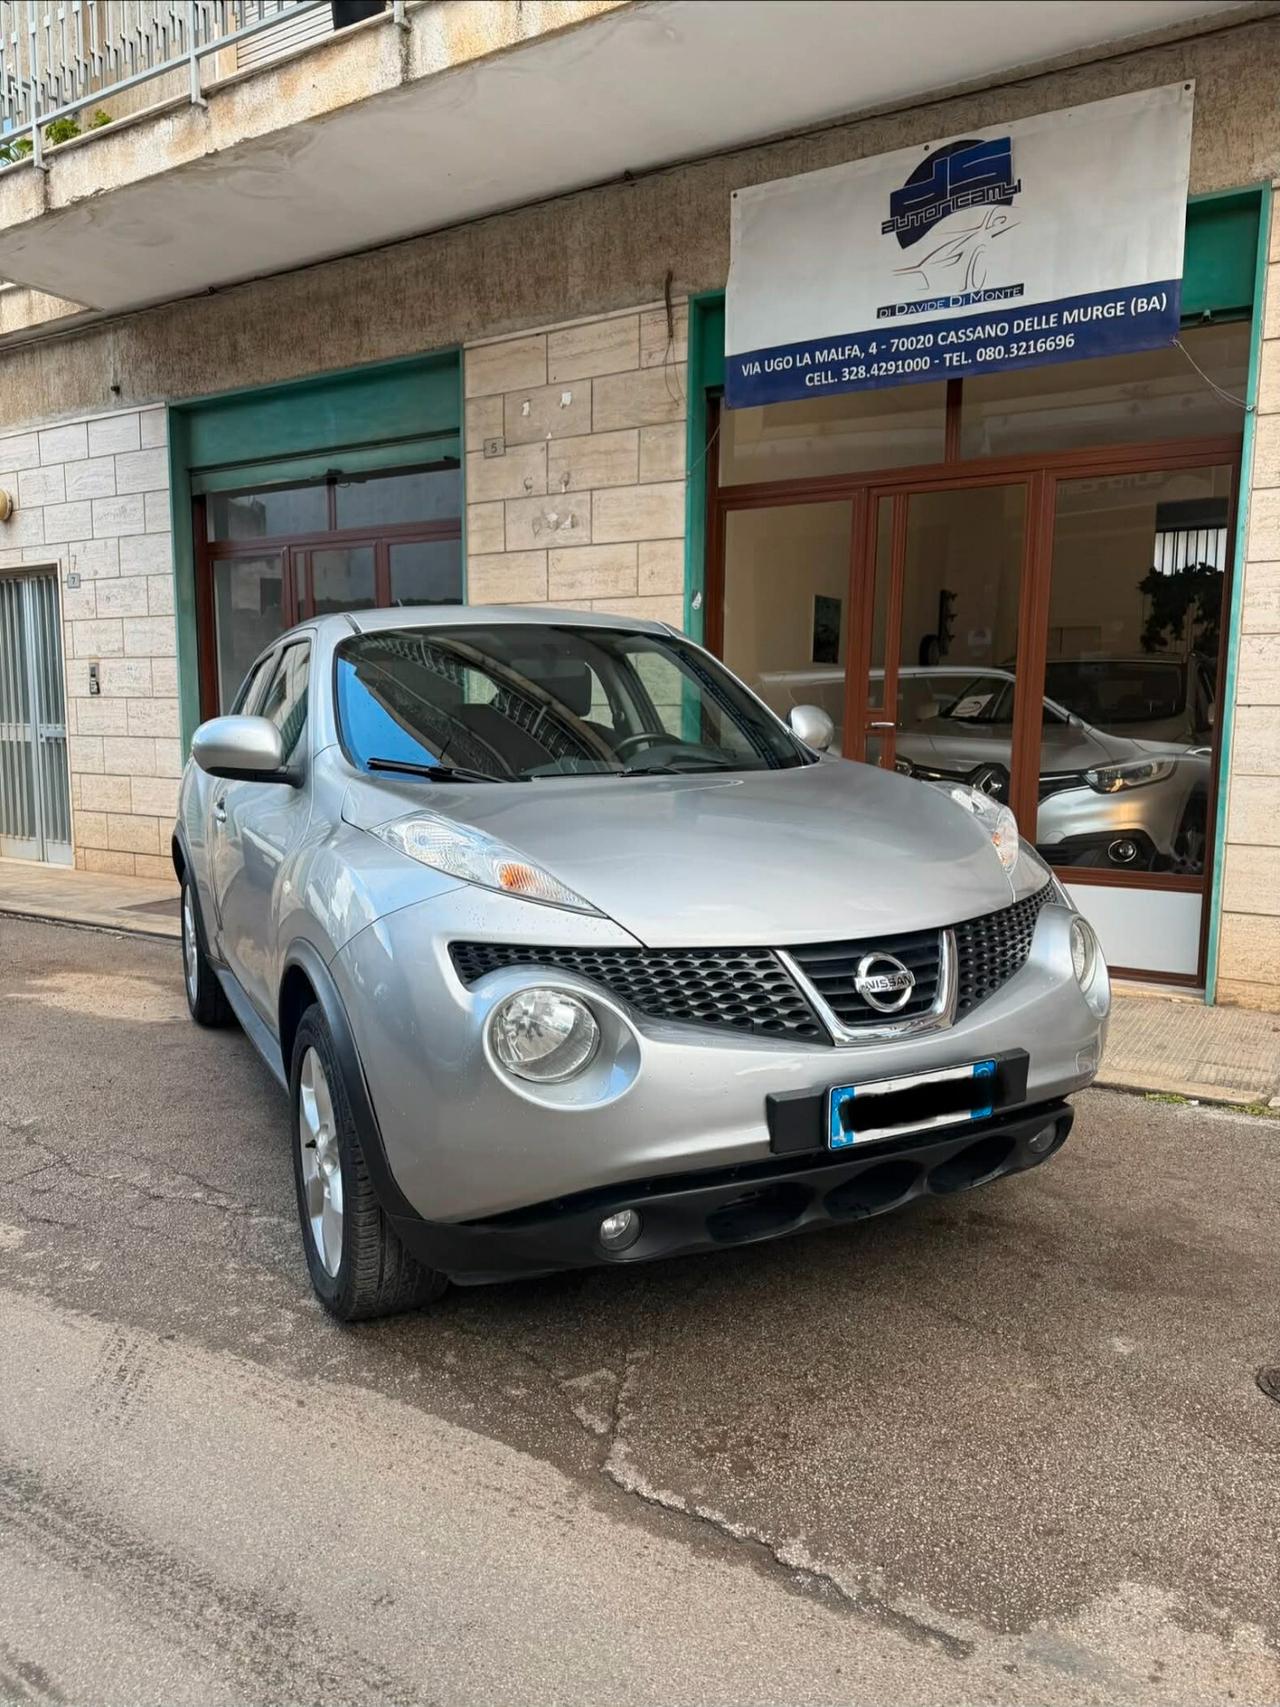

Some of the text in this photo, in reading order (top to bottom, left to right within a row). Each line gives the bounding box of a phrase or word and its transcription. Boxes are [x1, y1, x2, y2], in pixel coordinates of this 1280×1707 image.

[741, 361, 762, 377] VIA
[764, 355, 793, 373] UGO
[796, 352, 811, 367] LA
[815, 344, 865, 364] MALFA,
[868, 342, 878, 355] 4
[890, 334, 934, 353] 70020
[937, 322, 1009, 346] CASSANO
[1013, 313, 1058, 334] DELLE
[1062, 301, 1126, 325] MURGE
[1130, 292, 1167, 317] (BA)
[805, 370, 838, 387] CELL.
[841, 356, 930, 381] 328.4291000
[943, 352, 972, 367] TEL.
[976, 333, 1075, 362] 080.3216696
[491, 442, 498, 454] 5
[71, 577, 76, 585] 7
[863, 975, 912, 990] NISSAN
